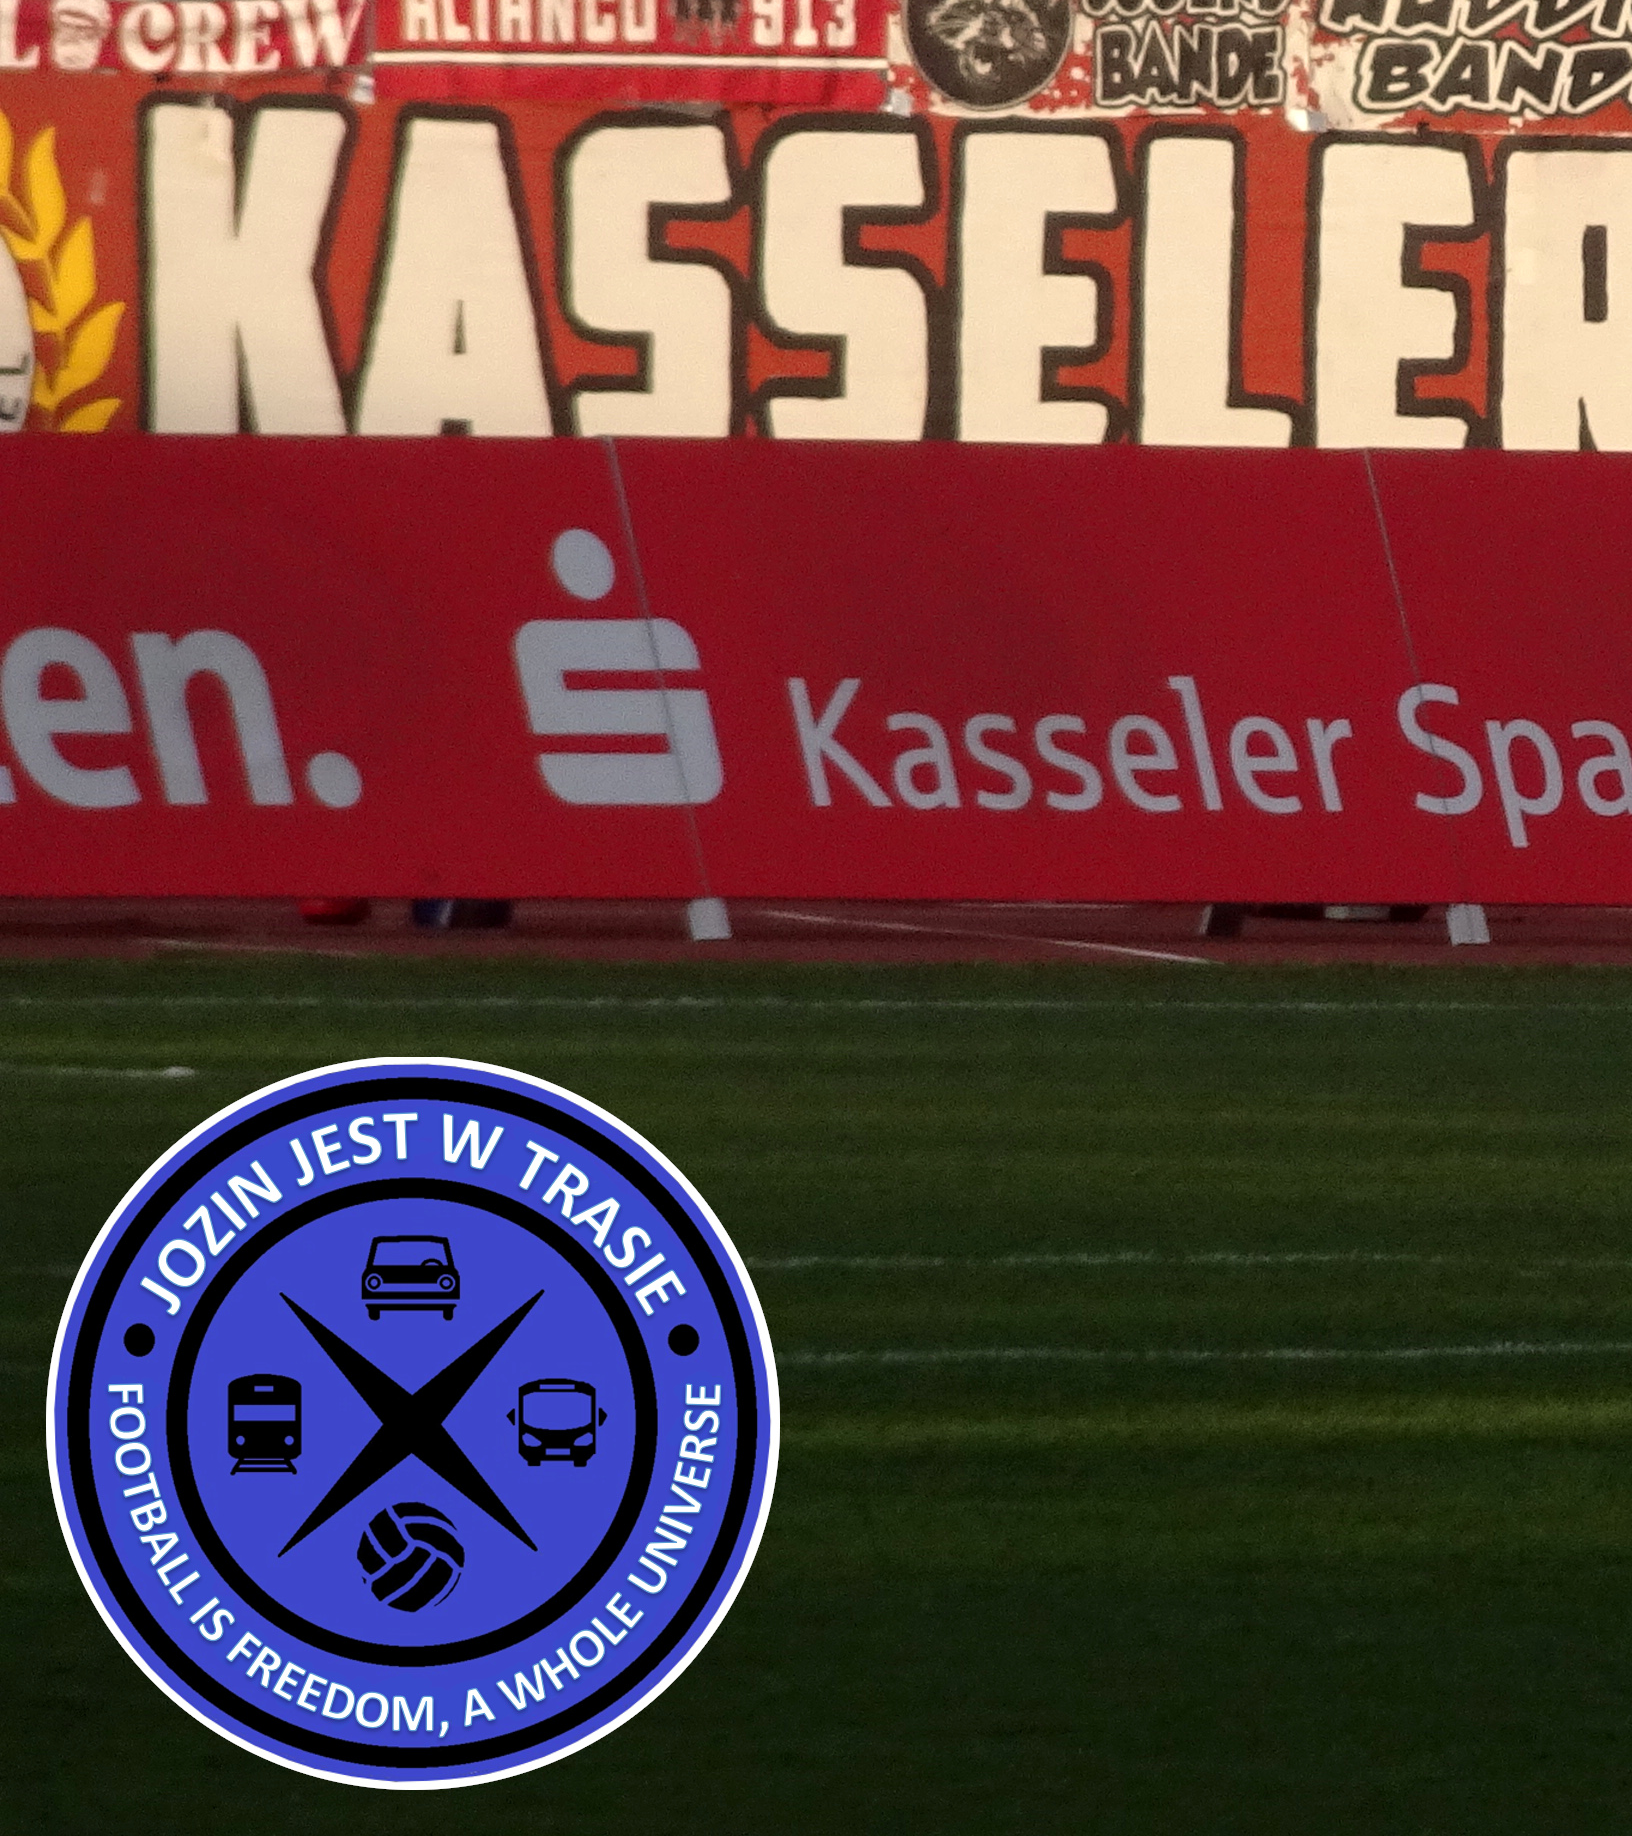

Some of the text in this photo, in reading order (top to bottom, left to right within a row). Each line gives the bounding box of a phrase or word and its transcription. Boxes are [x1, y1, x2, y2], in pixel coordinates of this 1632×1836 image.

[1095, 23, 1286, 107] BANDE
[0, 625, 363, 810] en.
[786, 674, 1352, 814] Kasseler
